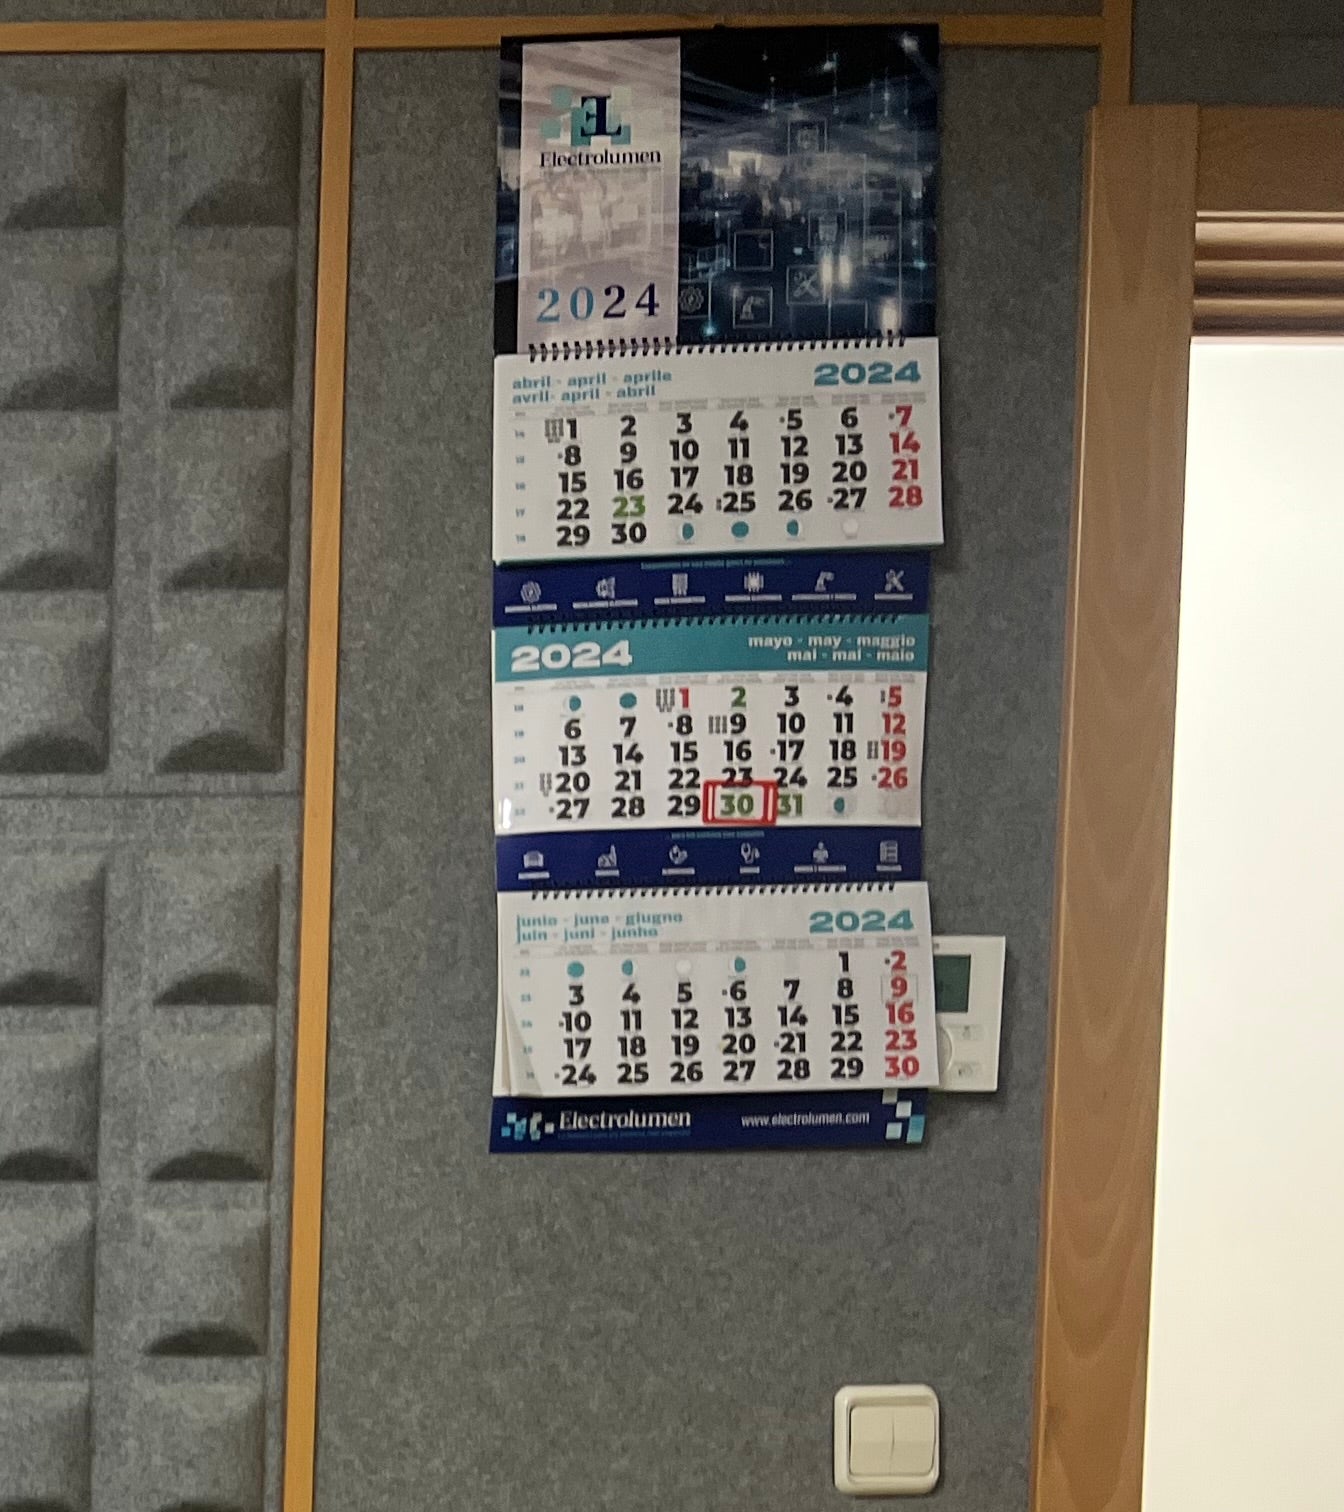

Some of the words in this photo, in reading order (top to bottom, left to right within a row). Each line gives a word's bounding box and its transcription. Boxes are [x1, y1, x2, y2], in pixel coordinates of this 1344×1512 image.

[539, 148, 662, 169] Electrolumen
[537, 282, 660, 324] 2024
[814, 361, 922, 387] 2024
[565, 417, 579, 441] 1
[620, 414, 637, 438] 2
[676, 411, 693, 435] 3
[729, 410, 749, 432] 4
[786, 407, 803, 431] 5
[840, 406, 859, 429] 6
[895, 405, 913, 427] 7
[564, 444, 582, 467] 8
[619, 441, 638, 465] 9
[669, 438, 700, 462] 10
[727, 436, 750, 460] 11
[780, 434, 809, 459] 12
[834, 432, 864, 456] 13
[889, 431, 921, 454] 14
[558, 470, 587, 495] 15
[613, 467, 644, 492] 16
[670, 465, 700, 489] 17
[723, 463, 754, 487] 18
[779, 461, 810, 485] 19
[831, 460, 868, 484] 20
[892, 458, 919, 481] 21
[556, 497, 590, 521] 22
[612, 495, 646, 518] 23
[667, 492, 704, 516] 24
[722, 490, 756, 514] 25
[777, 488, 813, 512] 26
[833, 486, 868, 511] 27
[888, 485, 923, 508] 28
[556, 524, 591, 548] 29
[611, 521, 647, 545] 30
[511, 640, 633, 672] 2024
[748, 636, 793, 650] mayo
[808, 635, 842, 649] may
[857, 634, 916, 650] maggio
[677, 687, 691, 709] 1
[731, 686, 747, 708] 2
[784, 684, 800, 708] 3
[835, 684, 854, 707] 4
[887, 685, 902, 708] 5
[564, 718, 582, 740] 6
[619, 715, 637, 738] 7
[675, 713, 694, 737] 8
[728, 712, 747, 736] 9
[776, 711, 806, 735] 10
[832, 711, 854, 735] 11
[882, 712, 906, 736] 12
[558, 744, 587, 767] 13
[612, 742, 644, 765] 14
[670, 740, 699, 764] 15
[723, 739, 752, 763] 16
[776, 739, 805, 763] 17
[828, 738, 857, 762] 18
[880, 739, 907, 763] 19
[555, 771, 591, 794] 20
[614, 769, 642, 792] 21
[668, 767, 701, 790] 22
[773, 766, 808, 789] 24
[826, 765, 858, 789] 25
[878, 766, 908, 790] 26
[556, 797, 591, 820] 27
[611, 795, 646, 819] 28
[667, 794, 701, 817] 29
[720, 793, 754, 816] 30
[776, 793, 804, 817] 31
[612, 925, 658, 941] junho
[625, 911, 683, 926] giugno
[809, 909, 914, 933] 2024
[838, 951, 850, 973] 1
[891, 950, 907, 971] 2
[568, 984, 585, 1007] 3
[622, 982, 641, 1005] 4
[677, 981, 693, 1004] 5
[729, 979, 747, 1002] 6
[783, 978, 801, 1001] 7
[836, 977, 854, 1000] 8
[890, 976, 908, 998] 9
[562, 1010, 592, 1033] 10
[620, 1009, 642, 1032] 11
[671, 1008, 699, 1031] 12
[724, 1006, 753, 1029] 13
[777, 1004, 809, 1028] 14
[831, 1003, 860, 1027] 15
[885, 1001, 915, 1025] 16
[563, 1037, 592, 1060] 17
[617, 1035, 647, 1058] 18
[670, 1034, 700, 1057] 19
[721, 1032, 756, 1056] 20
[779, 1031, 807, 1055] 21
[830, 1030, 863, 1053] 22
[885, 1029, 918, 1051] 23
[561, 1063, 597, 1087] 24
[616, 1061, 650, 1085] 25
[669, 1060, 704, 1084] 26
[723, 1059, 756, 1082] 27
[777, 1058, 811, 1081] 28
[830, 1056, 864, 1080] 29
[885, 1056, 920, 1078] 30
[559, 1108, 691, 1131] Electrolumen
[741, 1111, 870, 1128] www.electrolumen.com
